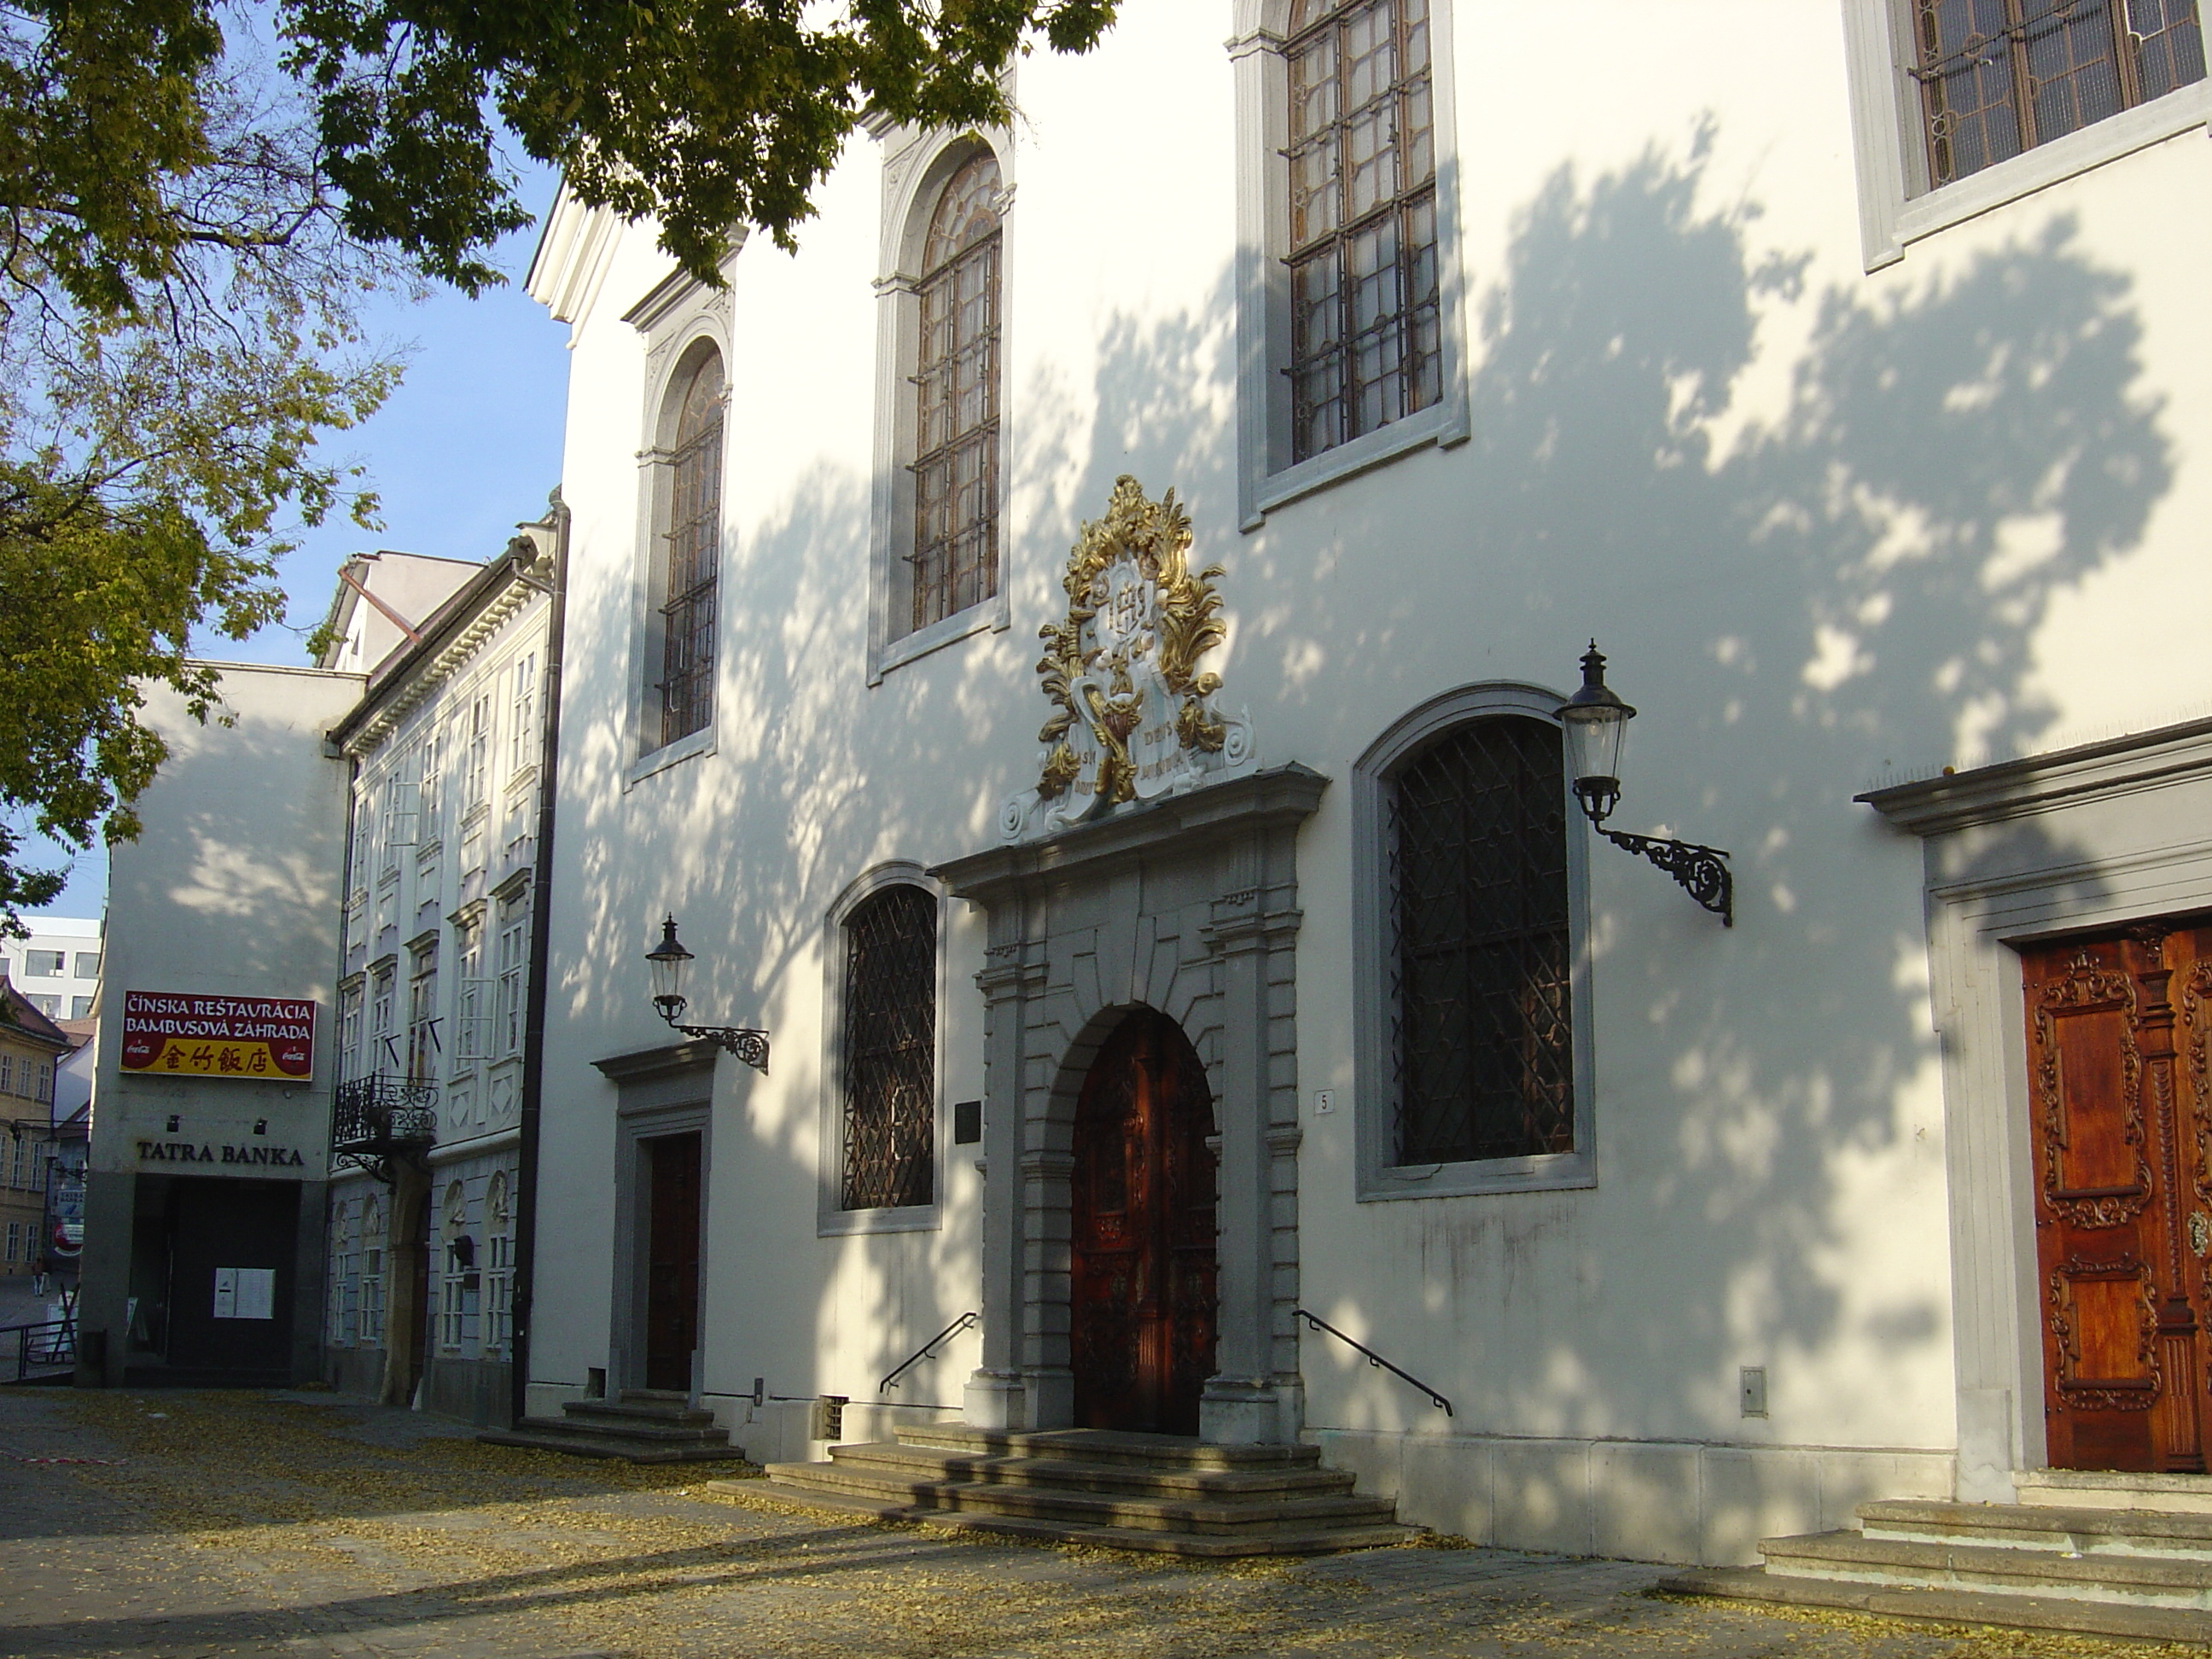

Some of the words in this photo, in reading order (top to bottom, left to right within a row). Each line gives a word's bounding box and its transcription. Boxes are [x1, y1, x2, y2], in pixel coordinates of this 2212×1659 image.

[127, 994, 189, 1014] ČÍNSKA
[194, 998, 311, 1020] REŠTAURÁCIA
[125, 1017, 230, 1037] BAMBUSOVÁ
[234, 1020, 311, 1040] ZÁHRADA
[162, 1045, 267, 1073] 金竹飯店
[1321, 1094, 1328, 1109] 5
[137, 1142, 213, 1162] TATRA
[221, 1145, 305, 1166] BANKA
